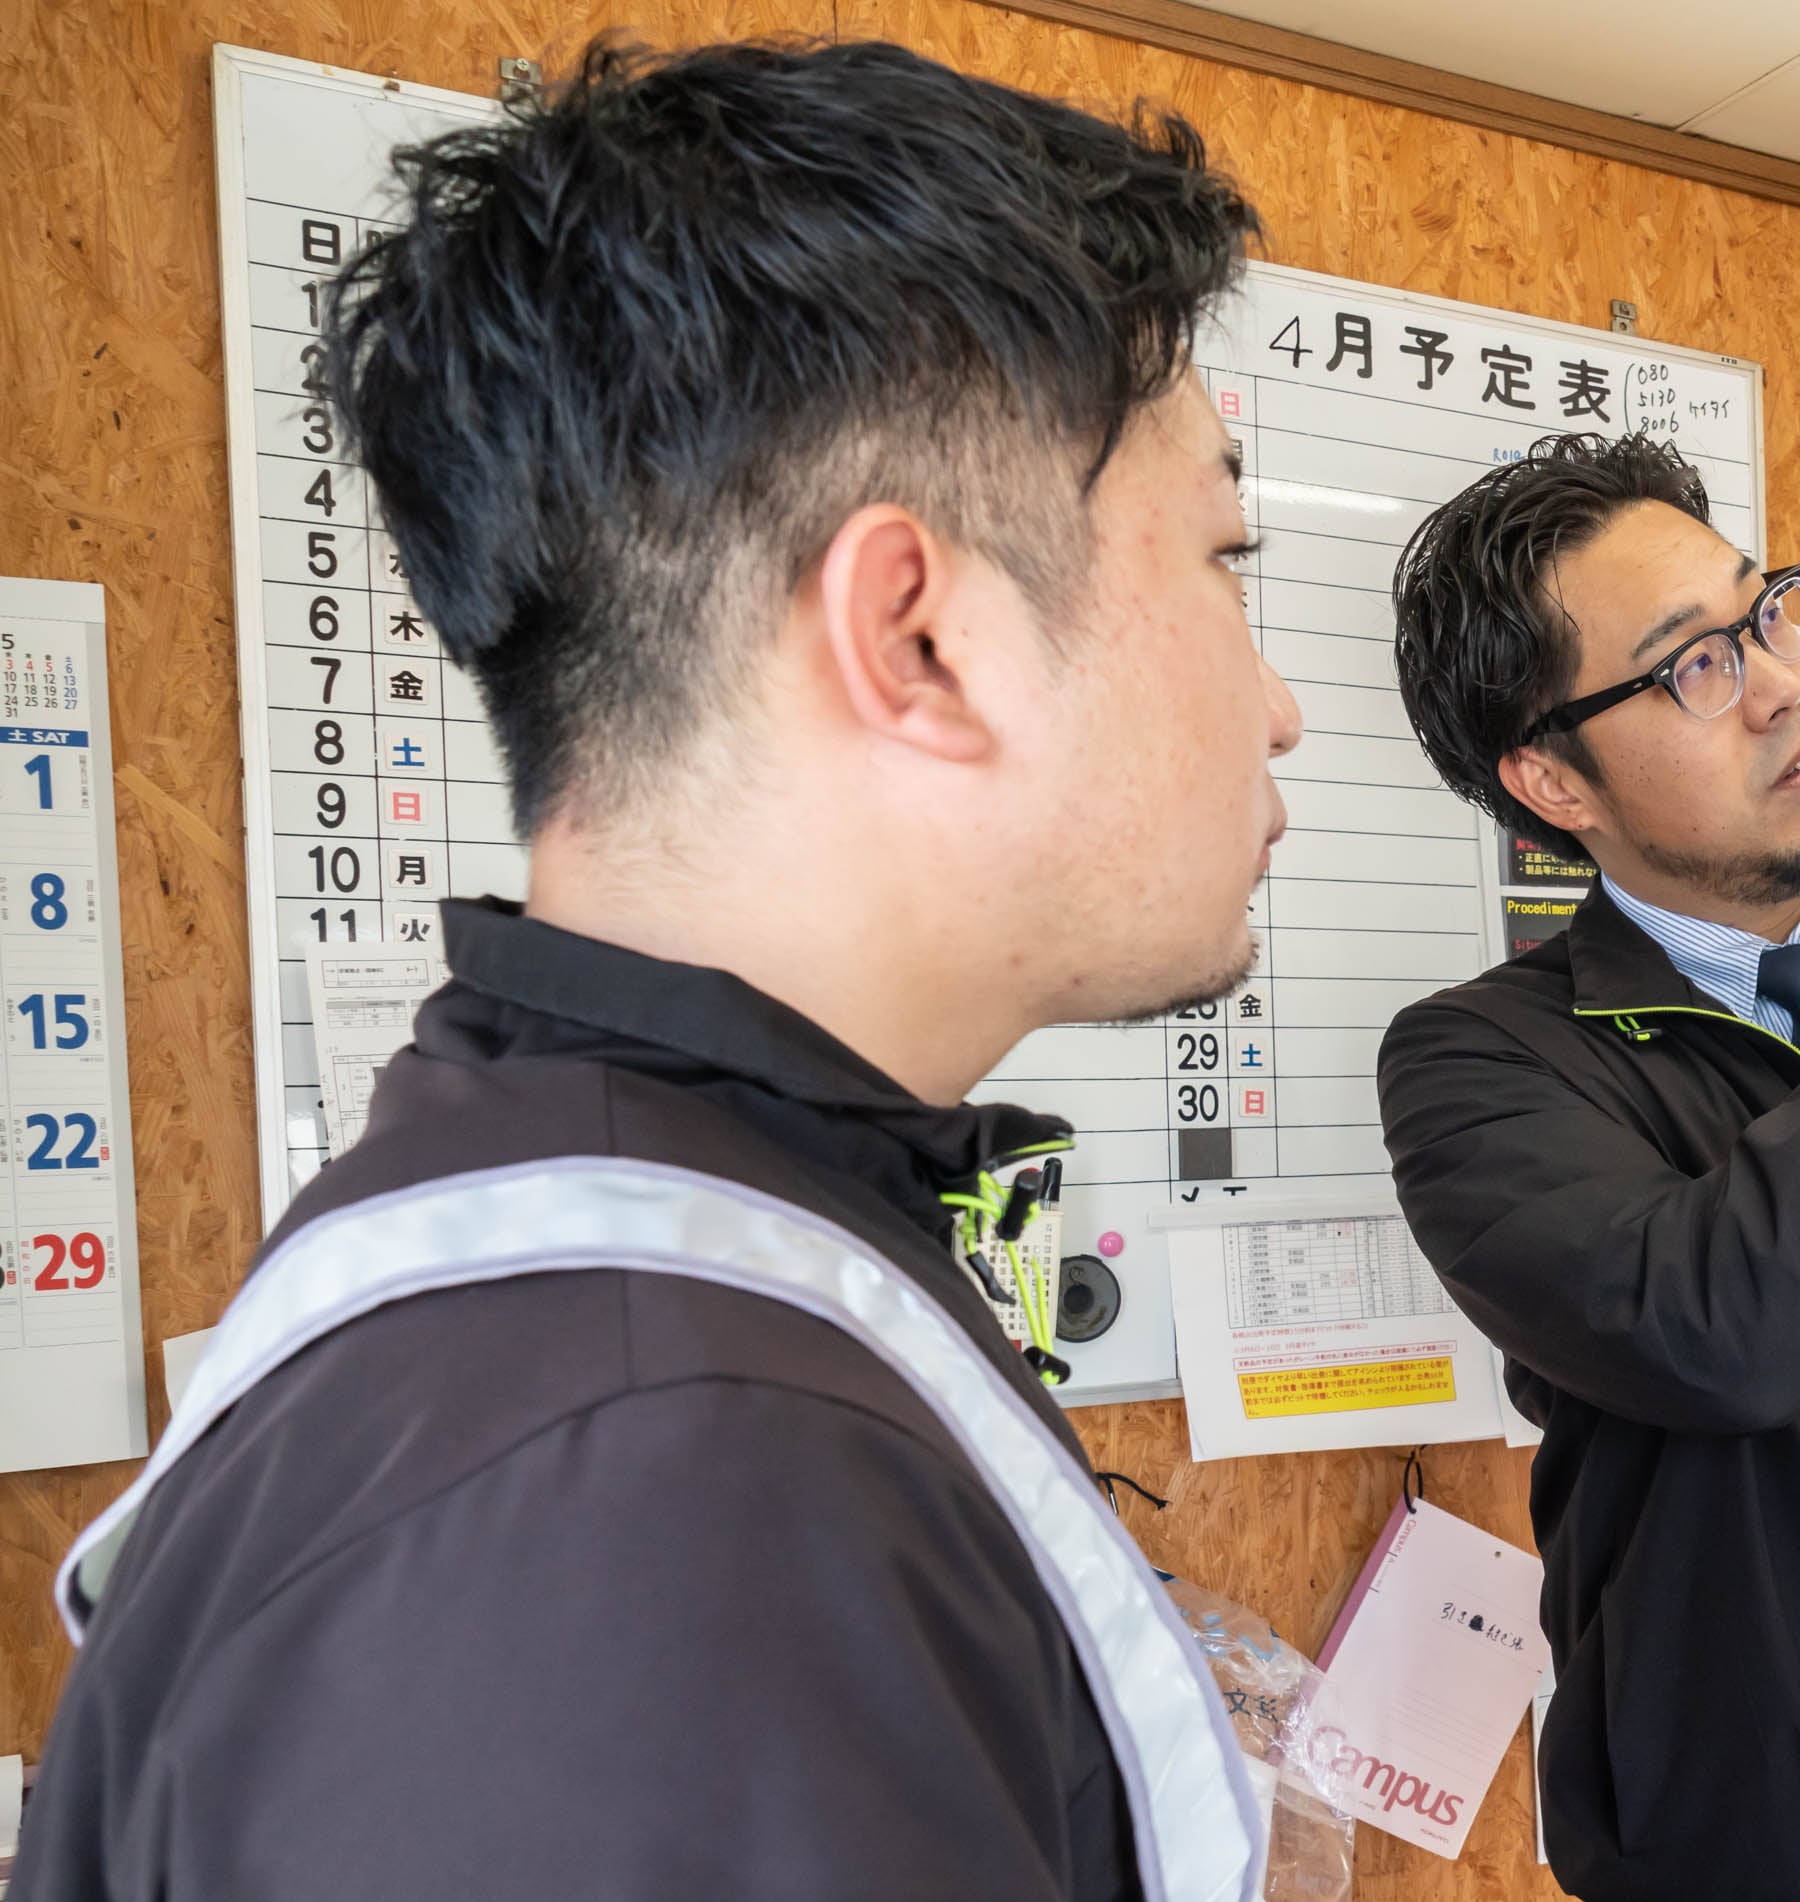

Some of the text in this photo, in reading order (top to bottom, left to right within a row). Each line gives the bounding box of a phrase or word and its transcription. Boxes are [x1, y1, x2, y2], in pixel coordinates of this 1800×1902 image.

[302, 220, 341, 265] 日
[302, 281, 318, 327] 1
[1269, 312, 1612, 424] 4月予定表
[1221, 392, 1240, 417] 日
[302, 408, 333, 454] 3
[304, 470, 336, 517] 4
[308, 532, 338, 578] 5
[1, 633, 15, 650] 5
[309, 596, 424, 642] 6 木
[4, 671, 77, 687] 10 11 12 13
[7, 660, 73, 674] 3 4 5 6
[310, 657, 424, 704] 7 金
[4, 695, 78, 710] 24 25 26 27
[5, 683, 78, 698] 17 18 19 20
[6, 707, 18, 718] 31
[8, 729, 70, 744] 土 SAT
[314, 720, 425, 767] 8 土
[24, 754, 54, 810] 1
[317, 783, 421, 829] 9 日
[308, 846, 428, 893] 10 月
[30, 872, 68, 931] 8
[310, 908, 431, 943] 11 火
[17, 994, 89, 1051] 15
[1239, 993, 1263, 1019] 金
[1177, 1033, 1263, 1070] 29 土
[1178, 1084, 1265, 1122] 30 日
[26, 1112, 99, 1171] 22
[33, 1232, 106, 1292] 29
[1309, 1725, 1465, 1826] Campus
